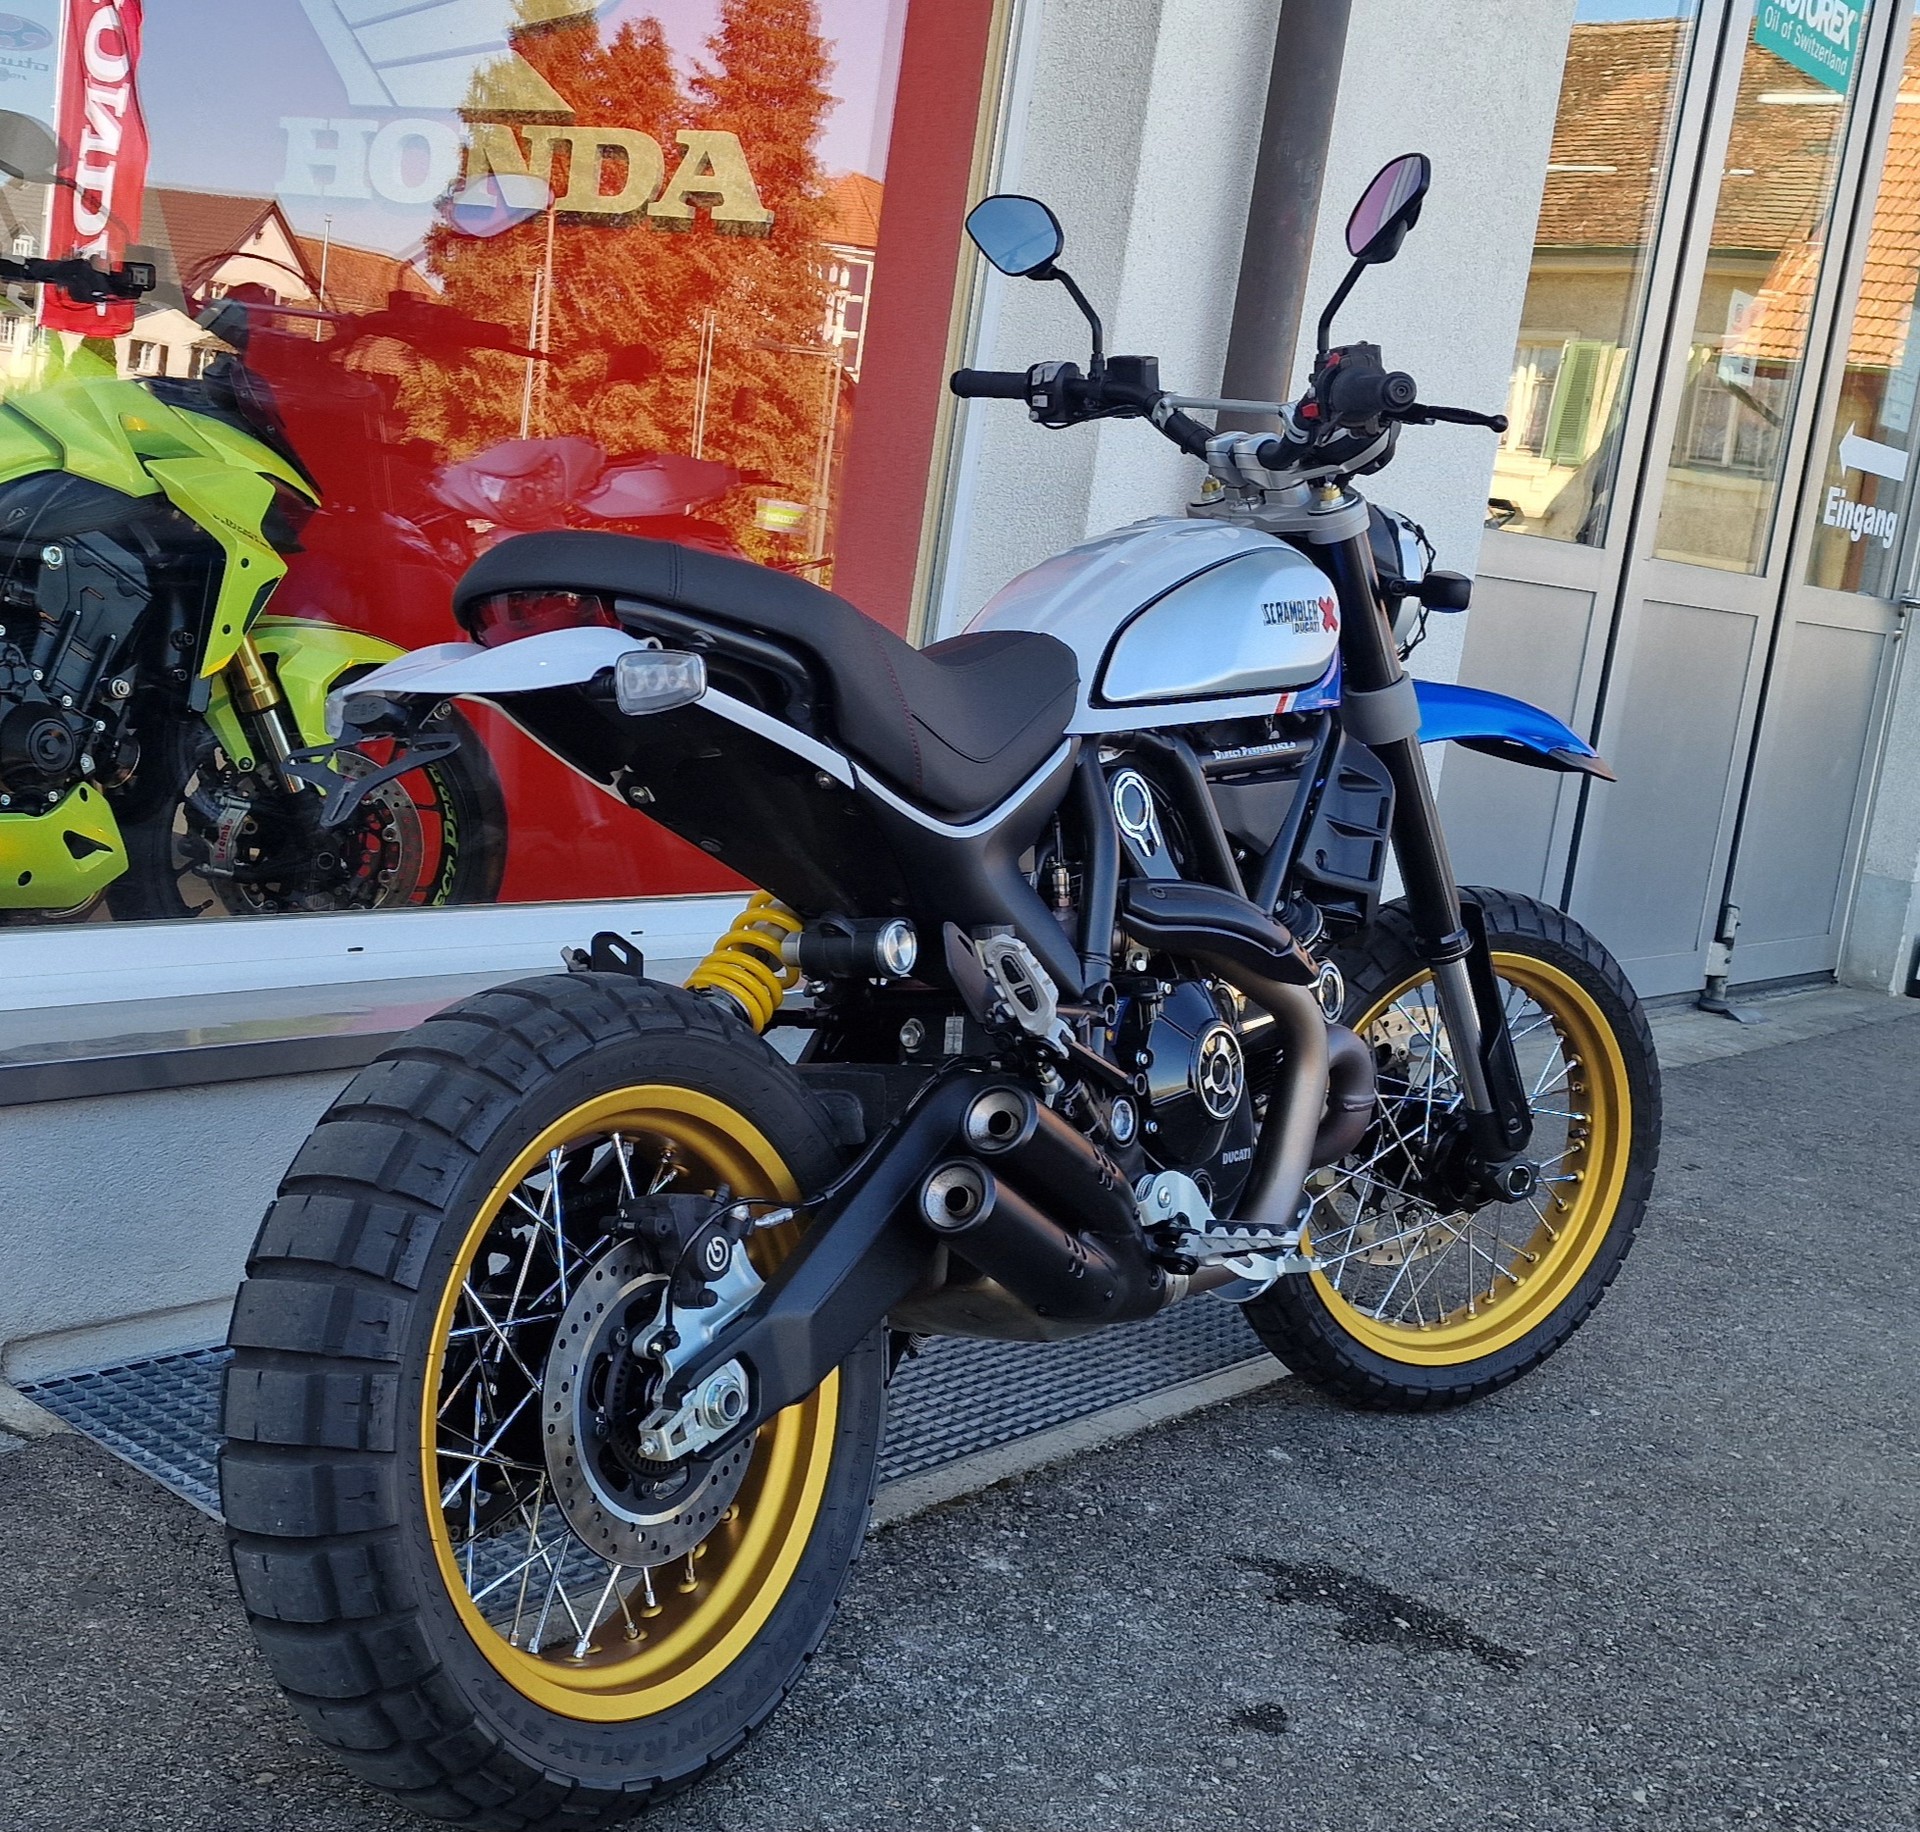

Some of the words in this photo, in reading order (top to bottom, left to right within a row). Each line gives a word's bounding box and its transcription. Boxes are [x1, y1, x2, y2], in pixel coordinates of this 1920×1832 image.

[1764, 6, 1780, 32] Oil
[1781, 20, 1794, 39] of
[1793, 25, 1849, 76] Switzerland
[273, 116, 776, 224] HONDA
[1823, 486, 1898, 549] Eingang
[1261, 600, 1319, 625] SCRAMBLER
[1293, 621, 1320, 634] DUCATI
[215, 818, 234, 860] brembo
[1222, 1147, 1251, 1165] DUCATI
